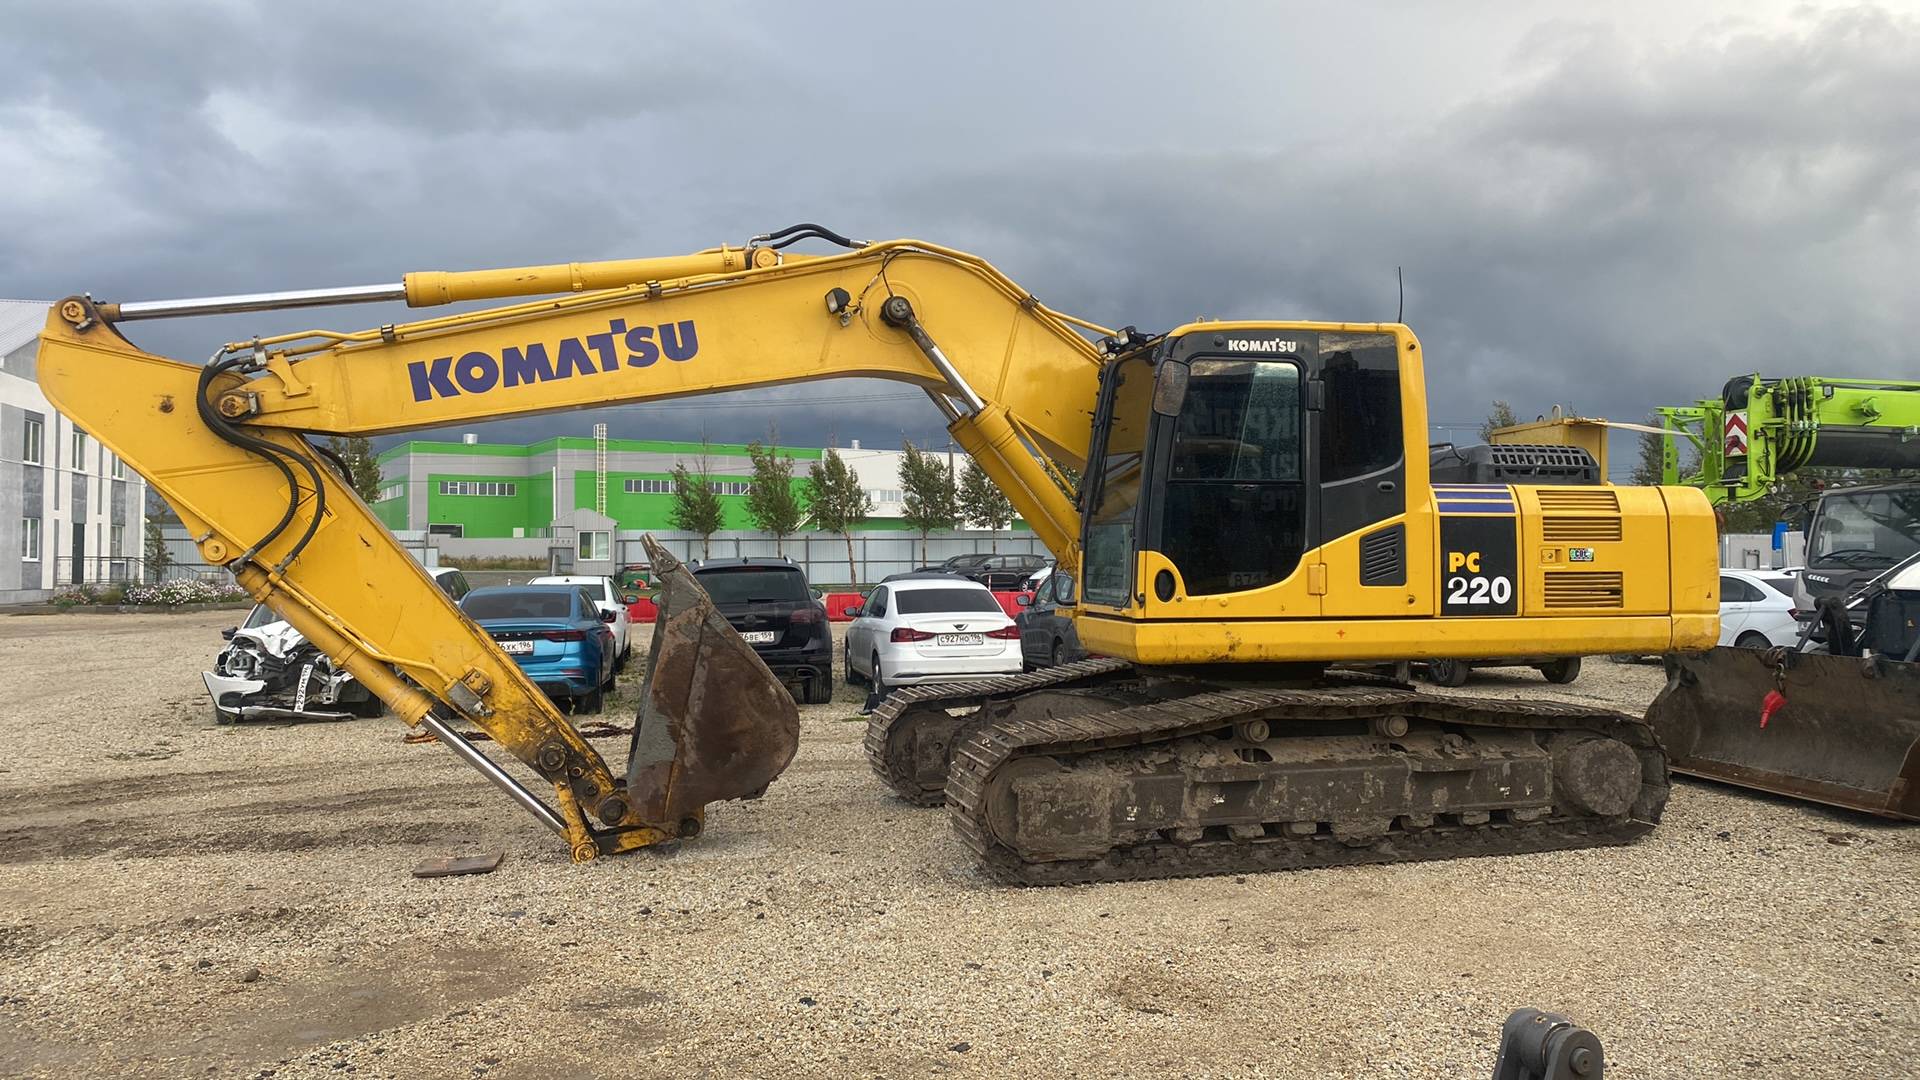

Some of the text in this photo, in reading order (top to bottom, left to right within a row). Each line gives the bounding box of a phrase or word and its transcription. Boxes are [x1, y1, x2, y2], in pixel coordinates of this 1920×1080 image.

[1228, 338, 1297, 352] KOMATSU
[408, 318, 699, 402] KOMATSU
[1449, 552, 1480, 573] PC
[1447, 576, 1512, 604] 220
